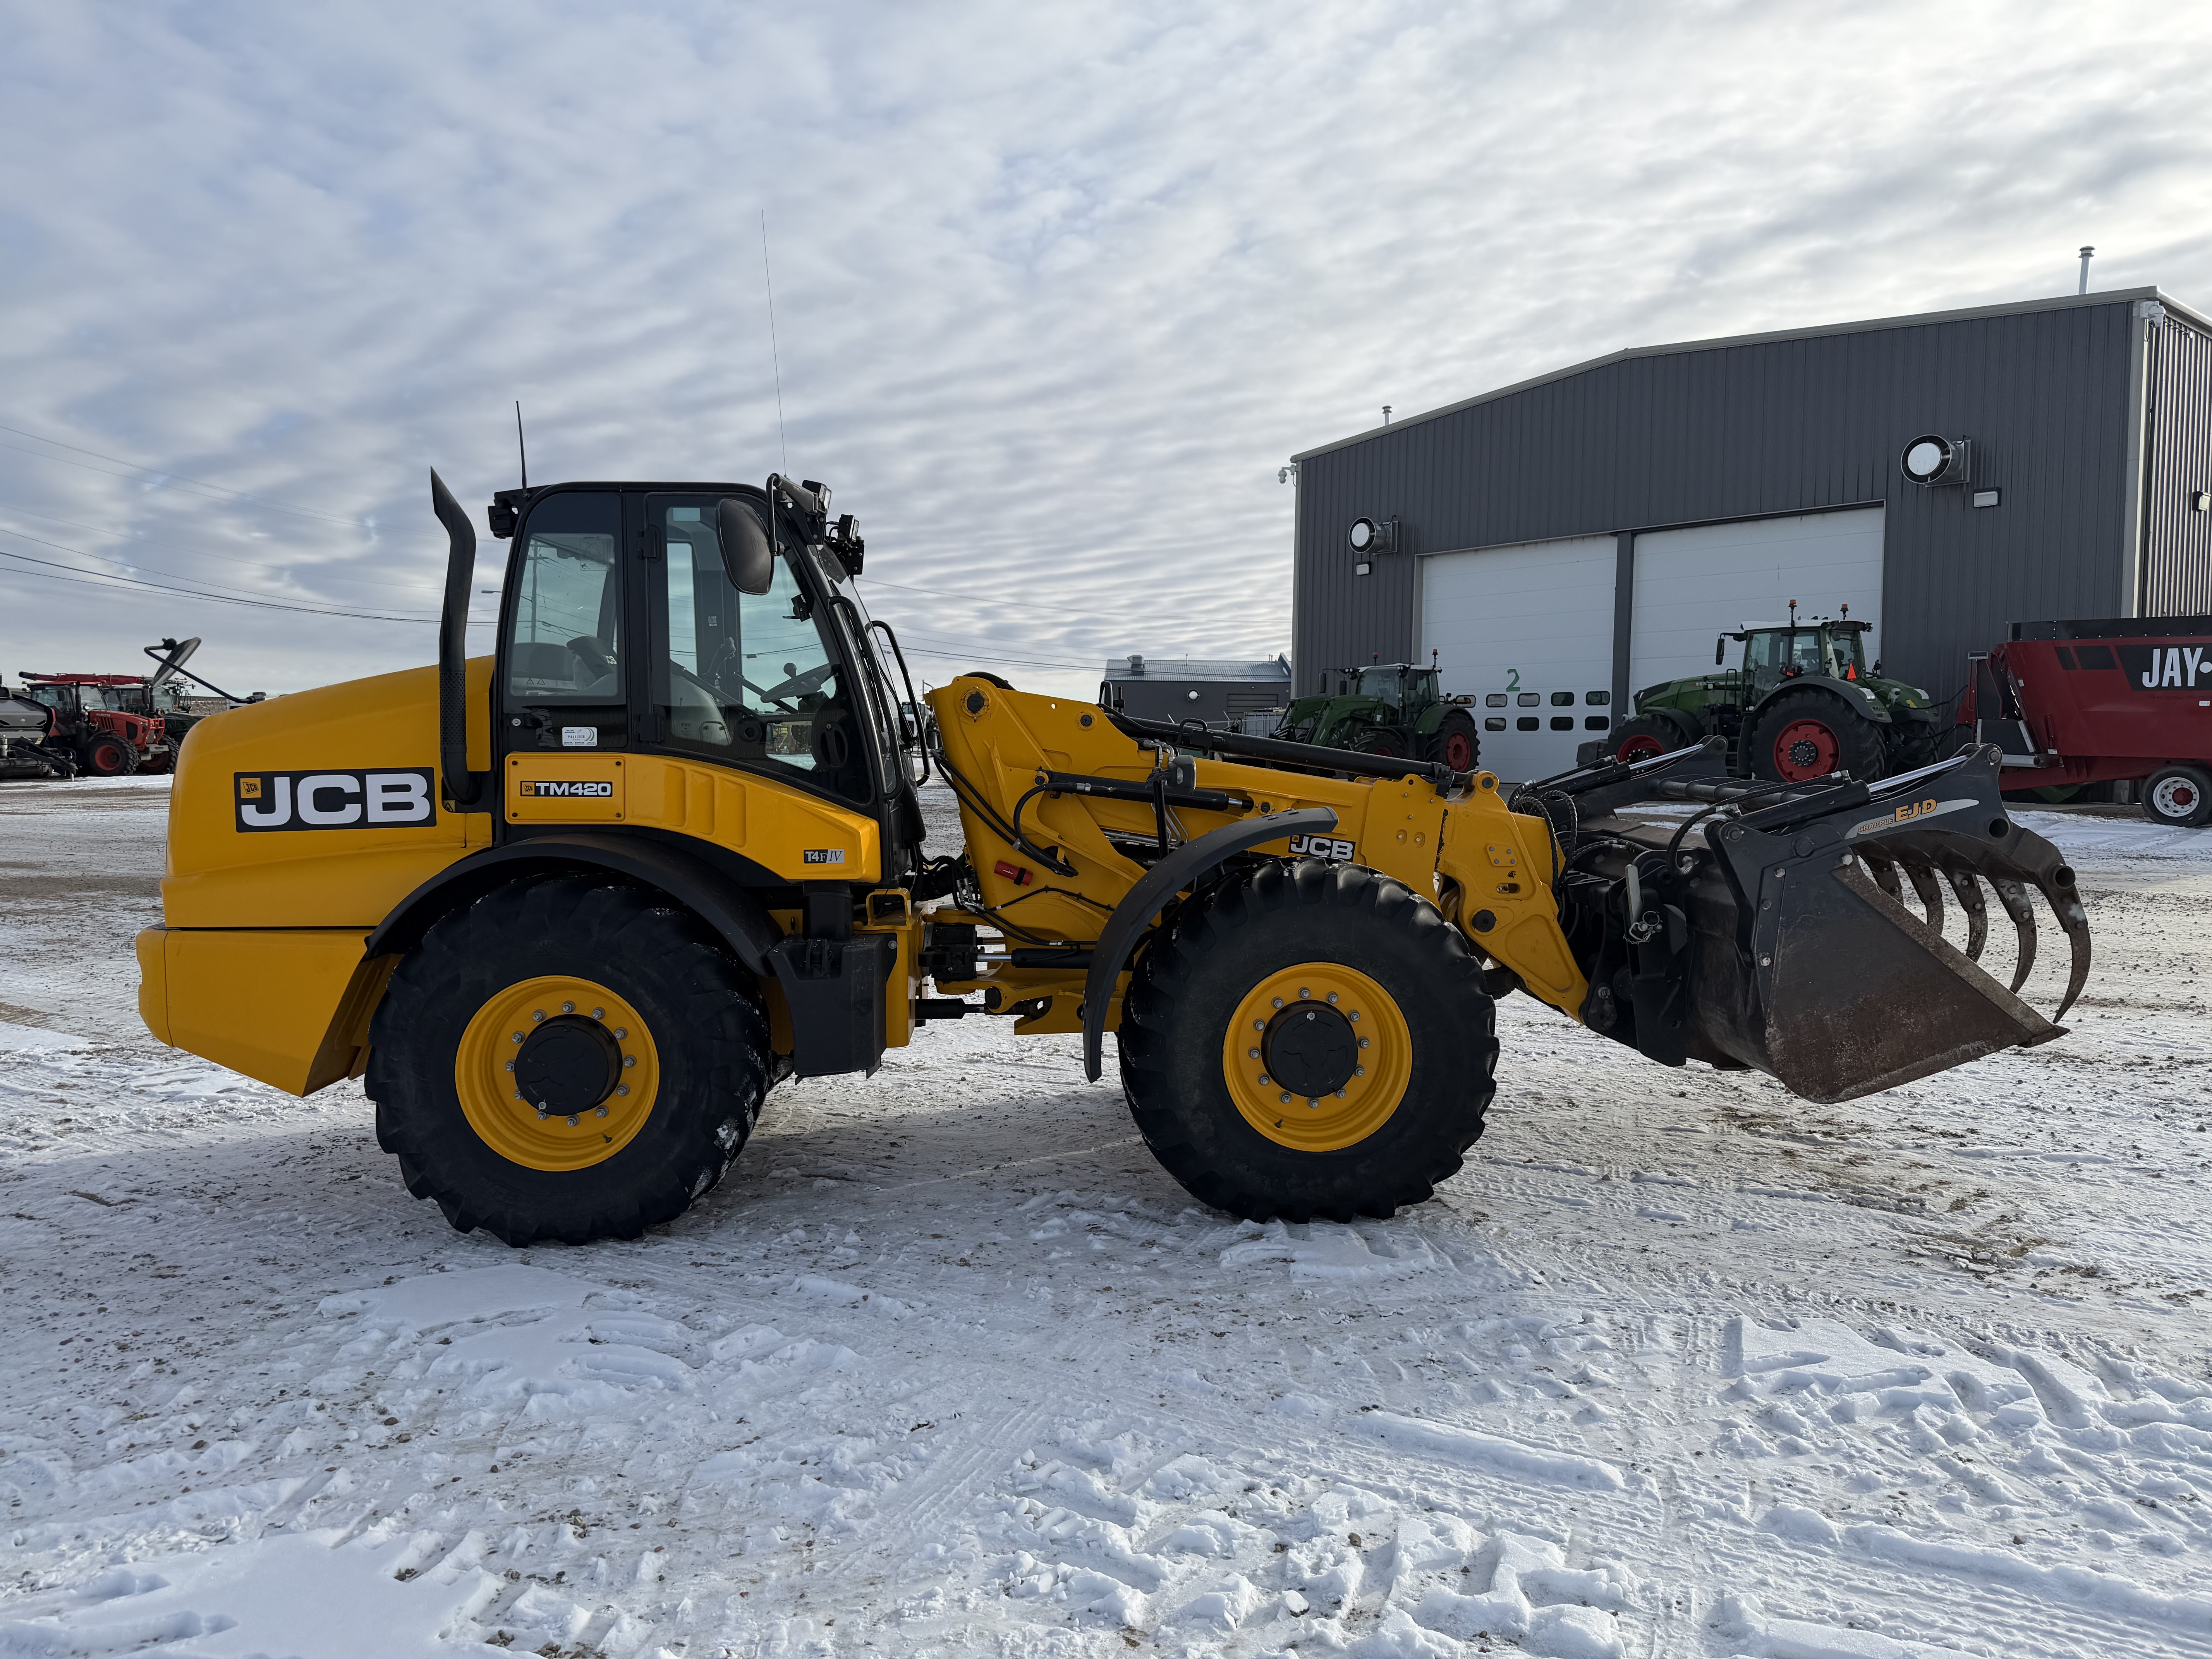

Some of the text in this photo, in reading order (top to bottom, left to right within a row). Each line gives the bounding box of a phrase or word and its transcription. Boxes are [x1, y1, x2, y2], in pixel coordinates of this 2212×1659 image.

[603, 655, 617, 664] CB
[1506, 669, 1520, 692] 2
[246, 783, 258, 792] JCB
[536, 783, 611, 796] TM420
[241, 773, 430, 826] JCB
[1858, 799, 1937, 832] GRAPPLE EJD
[1291, 836, 1353, 859] JCB
